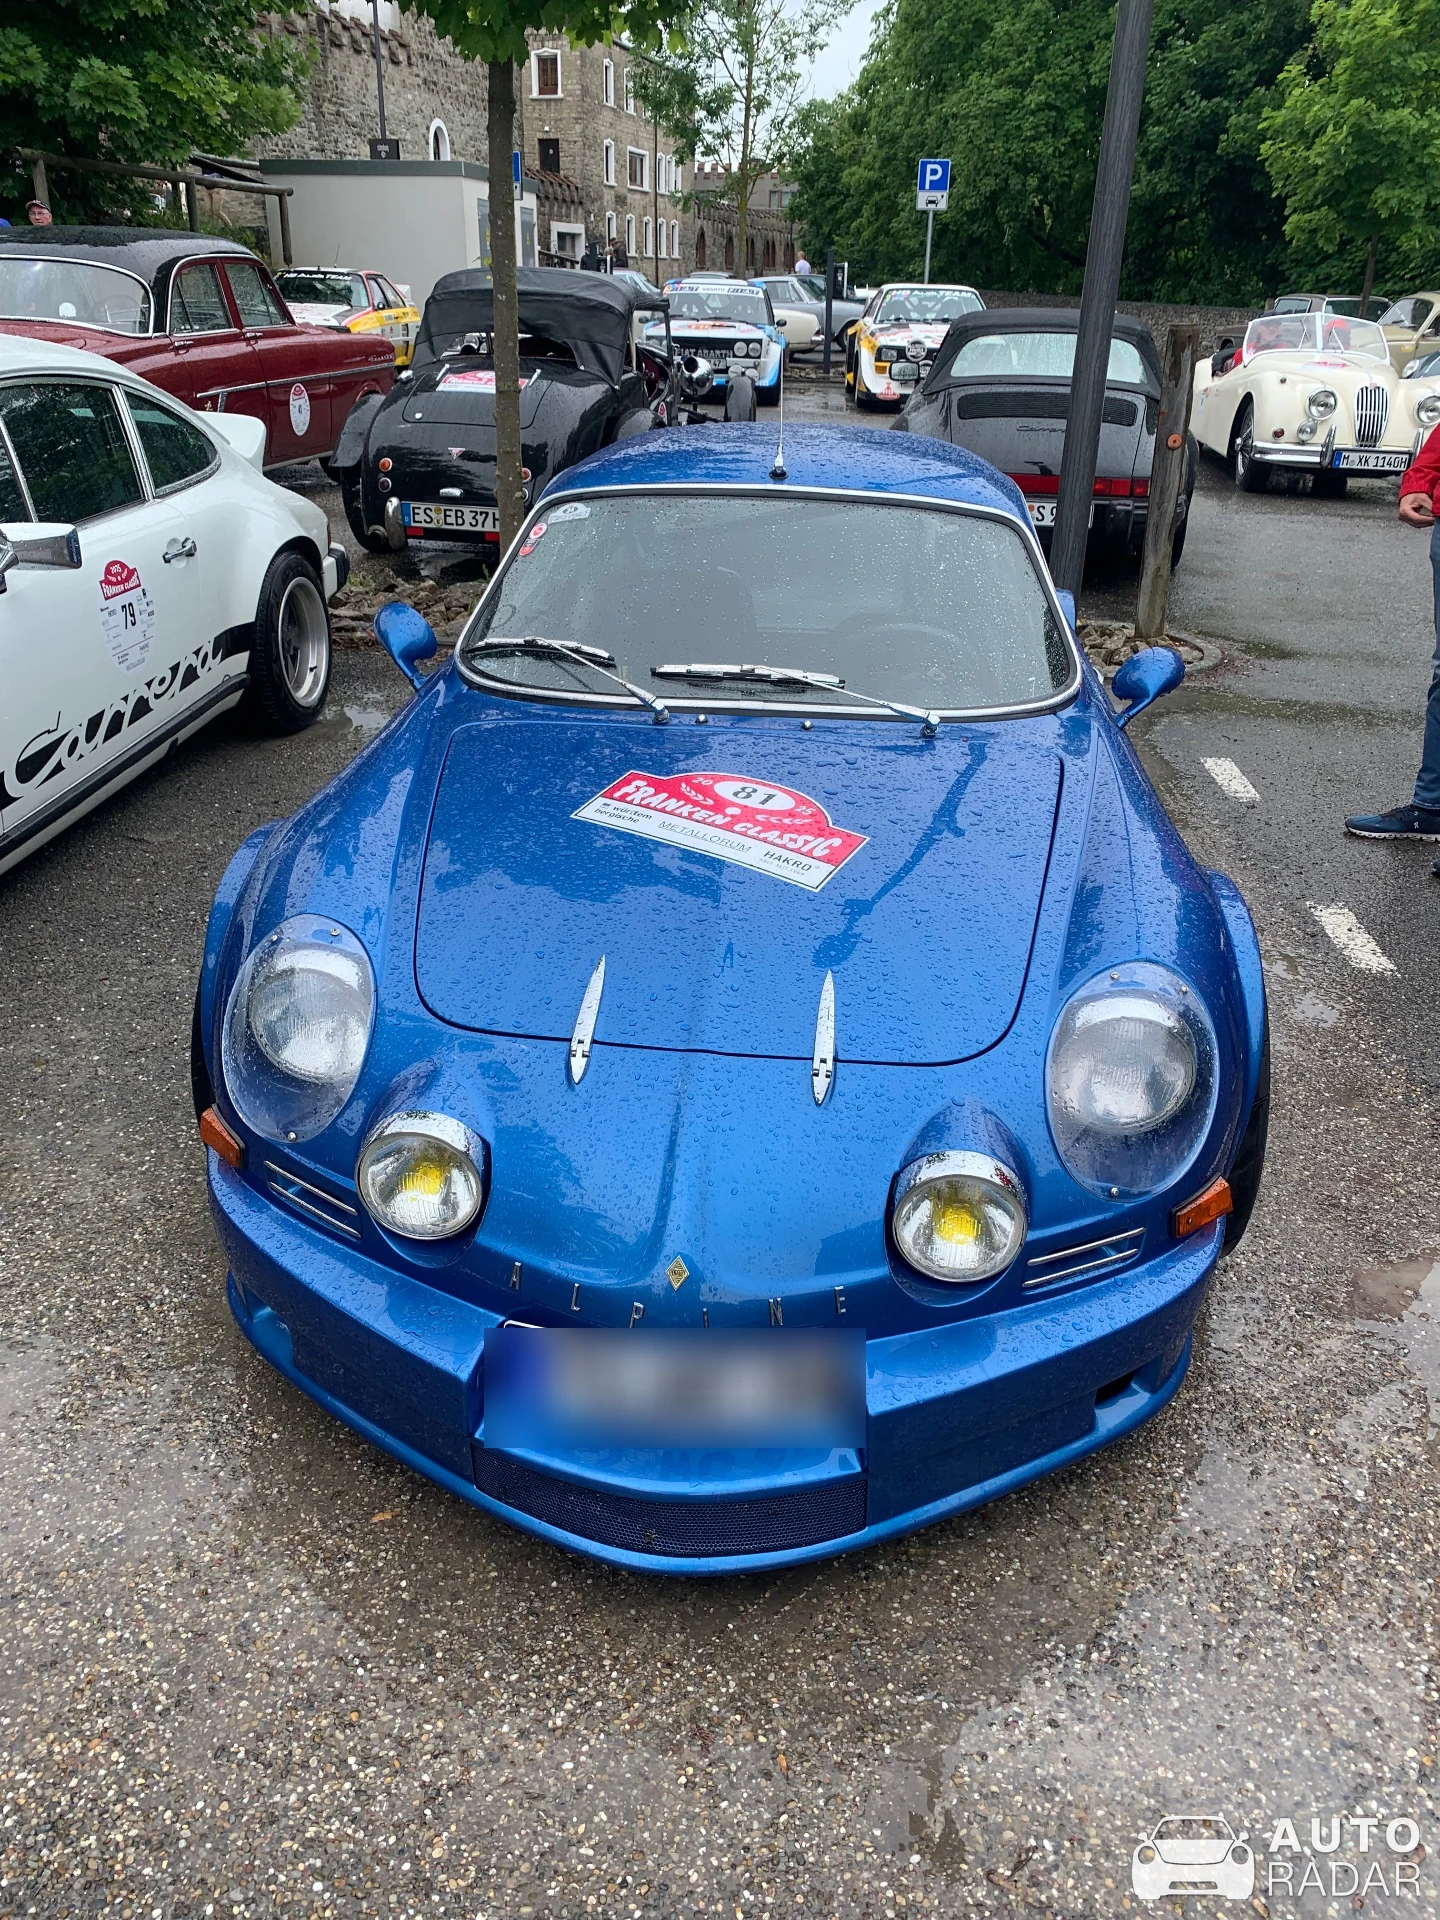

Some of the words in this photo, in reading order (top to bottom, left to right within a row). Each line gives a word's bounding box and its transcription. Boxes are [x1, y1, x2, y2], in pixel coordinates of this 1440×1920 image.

[925, 164, 943, 190] P
[1341, 454, 1351, 466] M
[1356, 455, 1372, 467] XK
[411, 506, 433, 525] ES
[443, 508, 466, 527] EB
[121, 601, 137, 630] 79
[3, 638, 225, 799] Carrera
[613, 805, 653, 820] württem
[732, 785, 777, 806] 81
[794, 805, 817, 816] 25
[594, 807, 640, 824] bergische
[612, 779, 733, 826] FRANKEN
[733, 822, 843, 857] CLASSIC
[658, 820, 752, 852] METALLORUM
[763, 850, 812, 872] HAKRO
